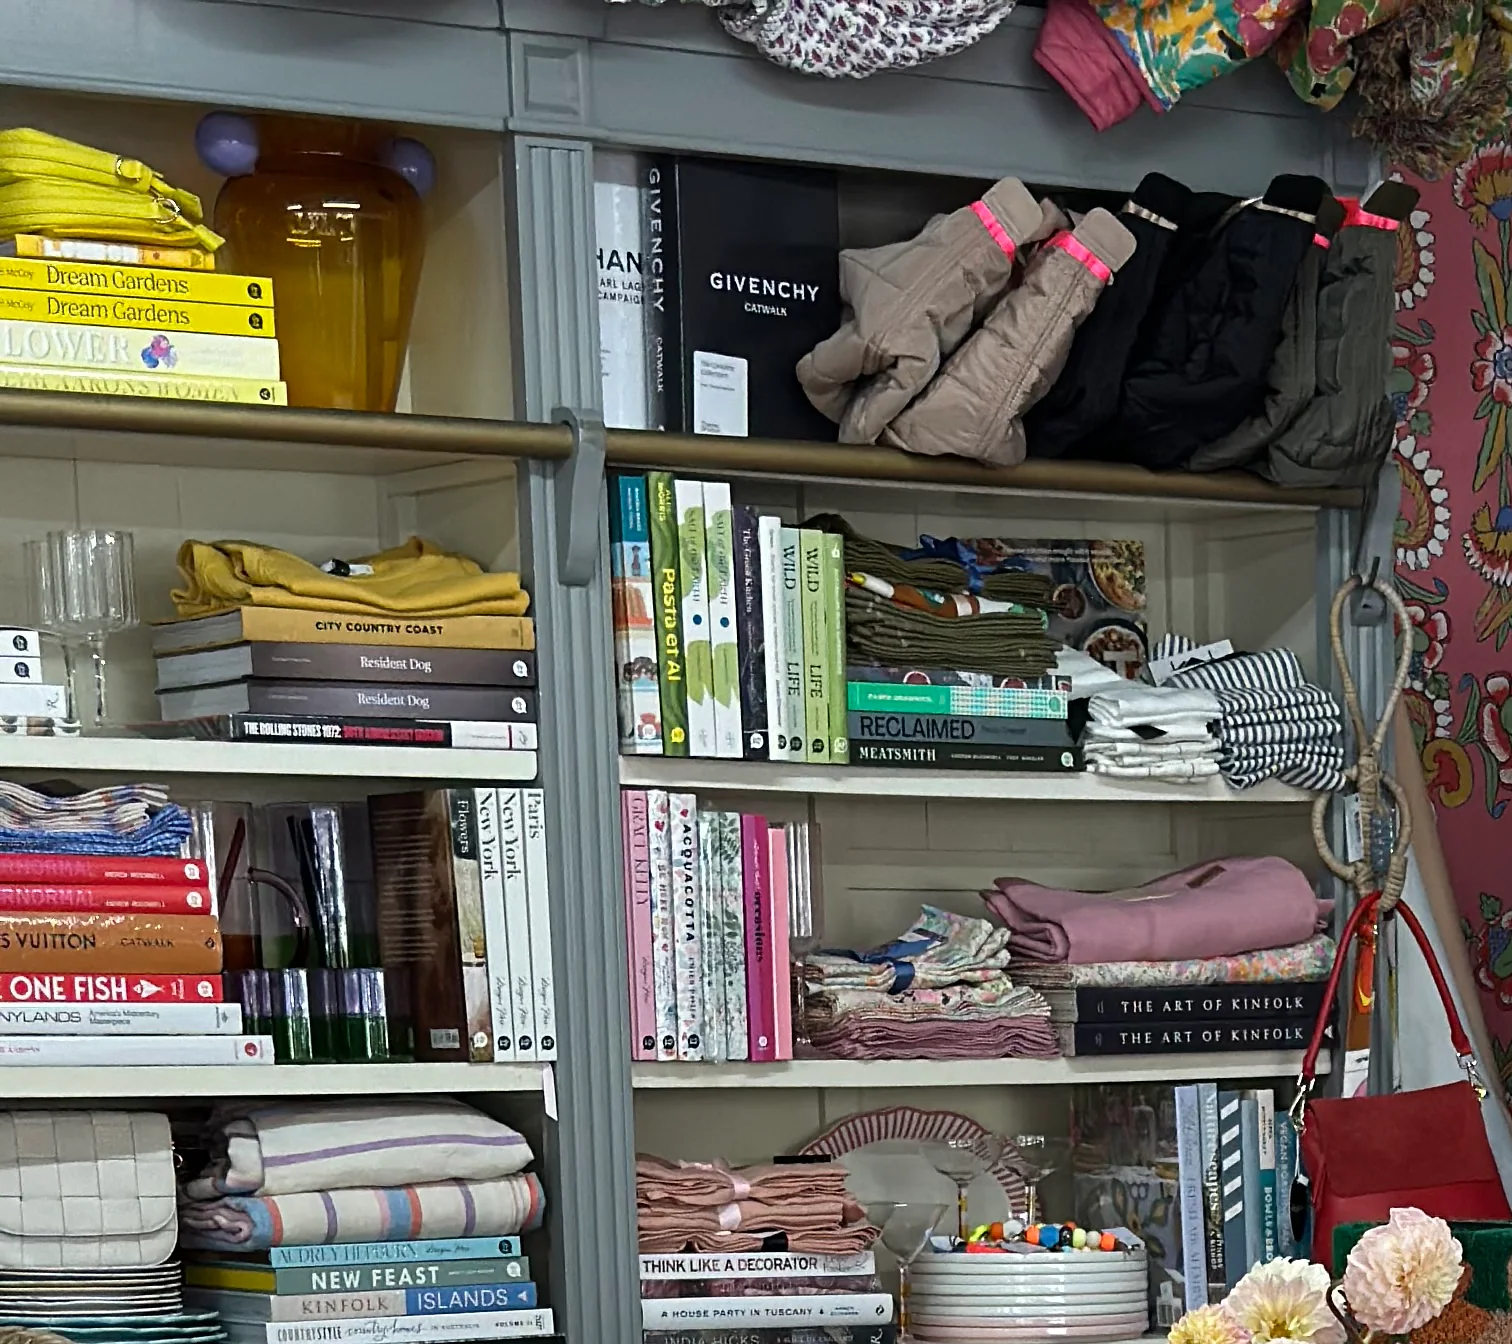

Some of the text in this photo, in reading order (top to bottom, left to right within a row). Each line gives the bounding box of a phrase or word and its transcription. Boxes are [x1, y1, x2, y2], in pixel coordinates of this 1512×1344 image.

[47, 265, 109, 289] Dream
[112, 269, 190, 295] Gardens
[649, 167, 665, 393] GIVENCHY CATWALK
[709, 272, 820, 302] GIVENCHY
[47, 296, 109, 320] Dream
[113, 301, 191, 326] Gardens
[744, 302, 788, 317] CATWALK
[315, 620, 444, 636] CITY COUNTRY COAST
[662, 567, 681, 681] Pasta et Al
[783, 545, 800, 697] WILD LIFE
[806, 547, 823, 699] WILD LIFE
[360, 655, 432, 674] Resident Dog
[357, 692, 430, 710] Resident Dog
[244, 721, 260, 736] THE
[260, 722, 292, 737] ROLLING
[293, 722, 322, 738] STONES
[860, 715, 976, 740] RECLAIMED
[859, 746, 937, 762] MEATSMITH
[456, 799, 470, 855] Flowers
[526, 792, 543, 840] Paris
[478, 791, 500, 881] New York
[501, 791, 522, 881] New York
[681, 824, 696, 941] ACQUACOTTA
[16, 932, 97, 950] VUITTON
[10, 976, 128, 1001] ONE FISH
[1121, 997, 1304, 1014] THE ART OF KINFOLK
[1120, 1027, 1304, 1045] THE ART OF KINFOLK
[643, 1258, 687, 1274] THINK
[689, 1258, 721, 1273] LIKE
[724, 1258, 735, 1272] A
[738, 1256, 818, 1272] DECORATOR
[312, 1266, 440, 1291] NEW FEAST
[302, 1288, 508, 1315] KINFOLK ISLANDS
[661, 1307, 813, 1319] A HOUSE PARTY IN TUSCANY
